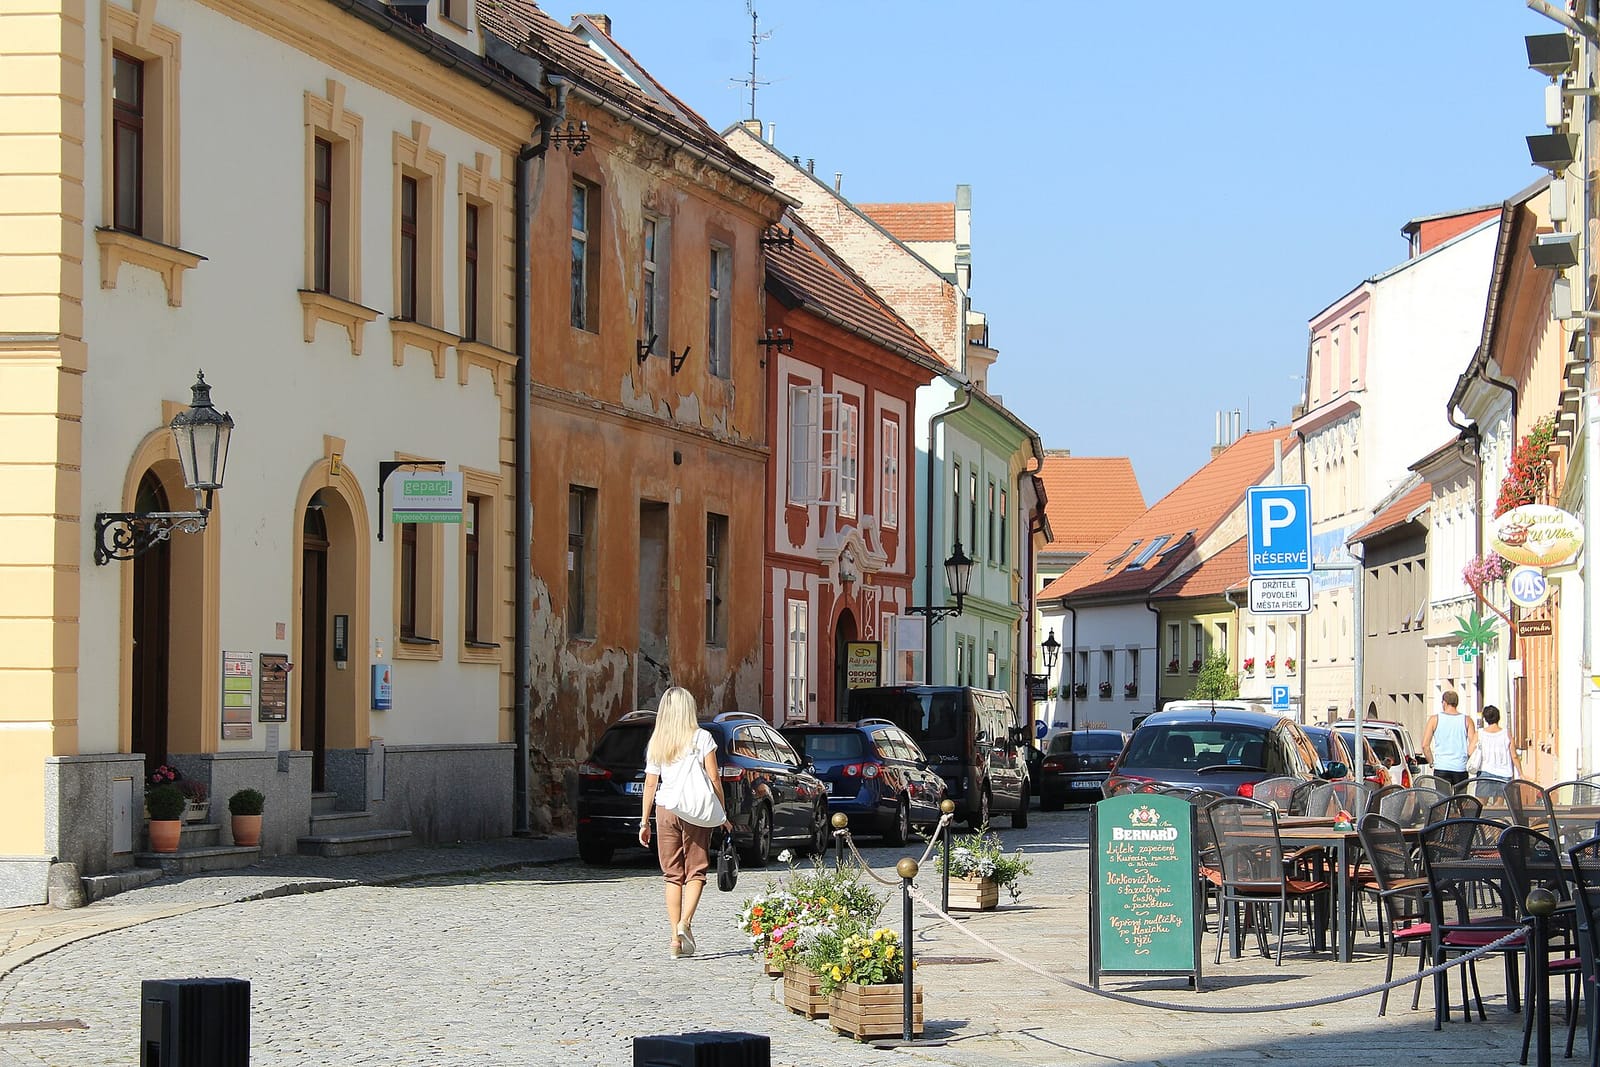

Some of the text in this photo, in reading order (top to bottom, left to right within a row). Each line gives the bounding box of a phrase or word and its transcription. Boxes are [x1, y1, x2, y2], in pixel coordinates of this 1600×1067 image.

[1261, 497, 1297, 547] P
[1511, 512, 1564, 524] Obchod
[1253, 551, 1307, 565] RÉSERVÉ
[1262, 581, 1296, 590] DRŽITELE
[1261, 590, 1298, 599] POVOLENÍ
[1256, 600, 1303, 609] MĚSTA PÍSEK
[1520, 622, 1551, 634] gurmán
[1275, 688, 1286, 703] P
[1112, 827, 1178, 841] BERNARD
[1106, 842, 1134, 855] Lilek
